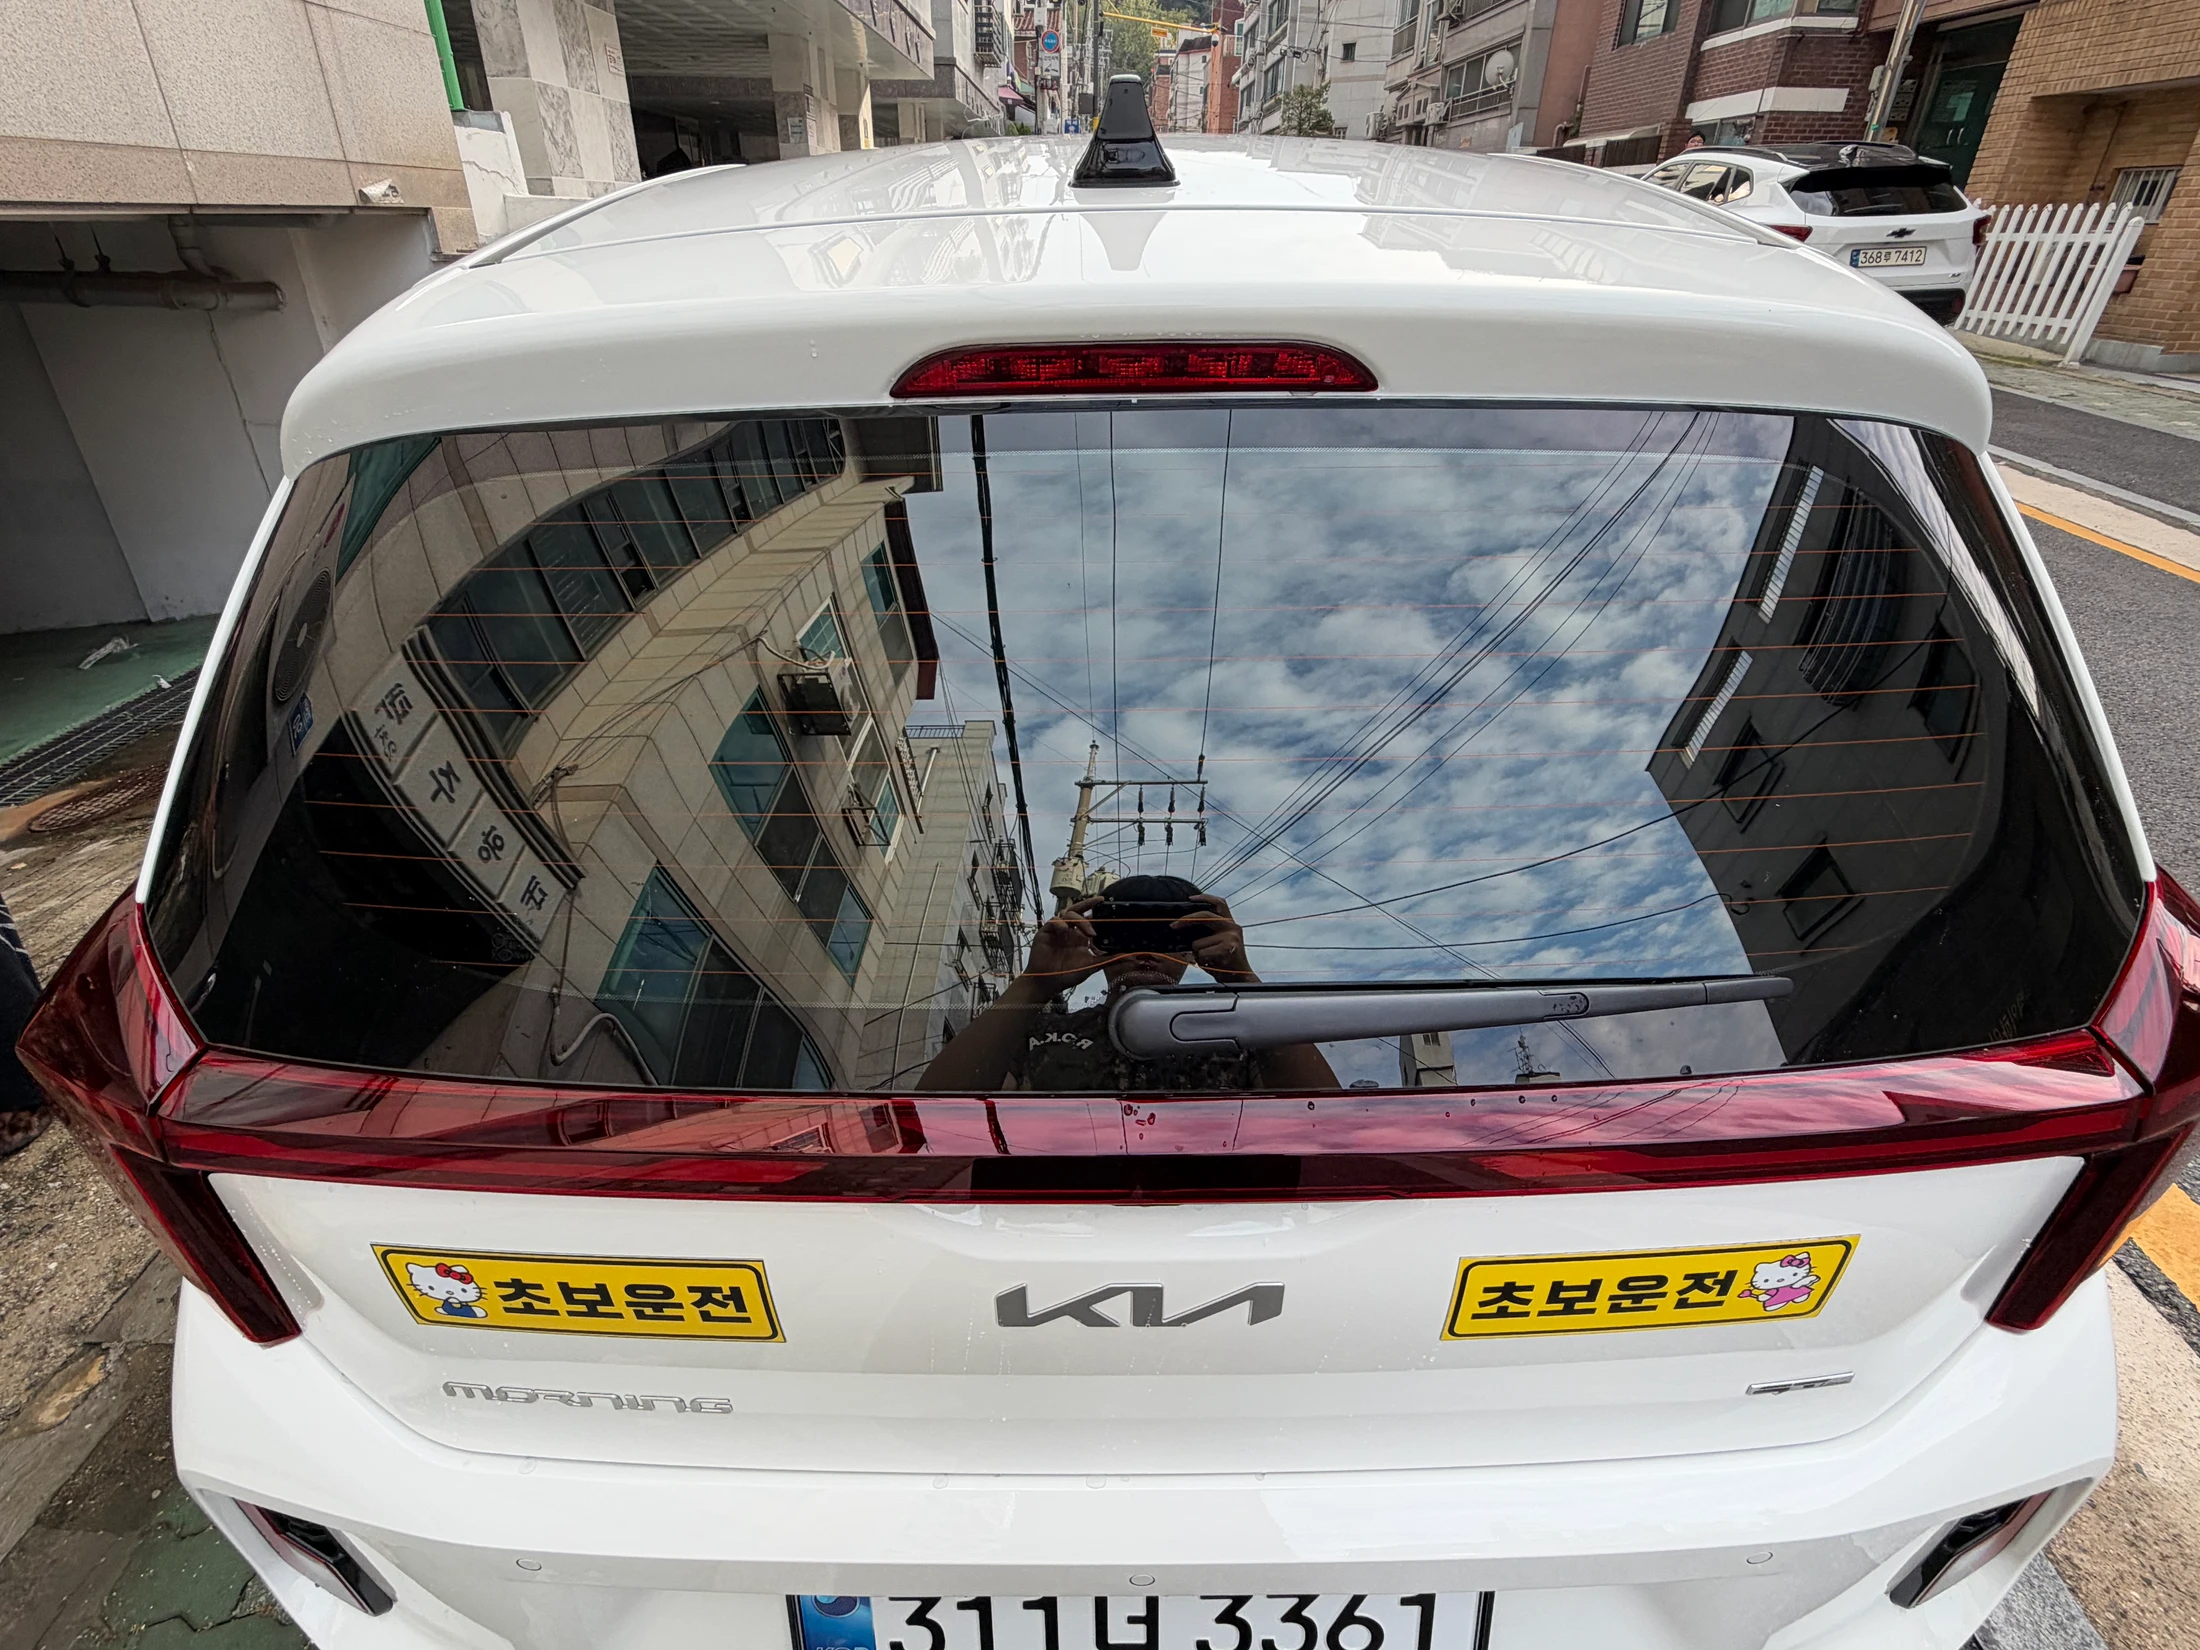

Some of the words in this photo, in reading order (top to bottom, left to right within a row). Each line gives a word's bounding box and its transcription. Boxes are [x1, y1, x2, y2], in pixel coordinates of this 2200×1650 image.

[1894, 249, 1923, 263] 7412
[493, 1277, 753, 1324] 초보운전
[994, 1282, 1286, 1328] KIA
[1470, 1269, 1739, 1321] 초보운전
[442, 1381, 734, 1415] MORNING
[1195, 1593, 1436, 1650] 3361
